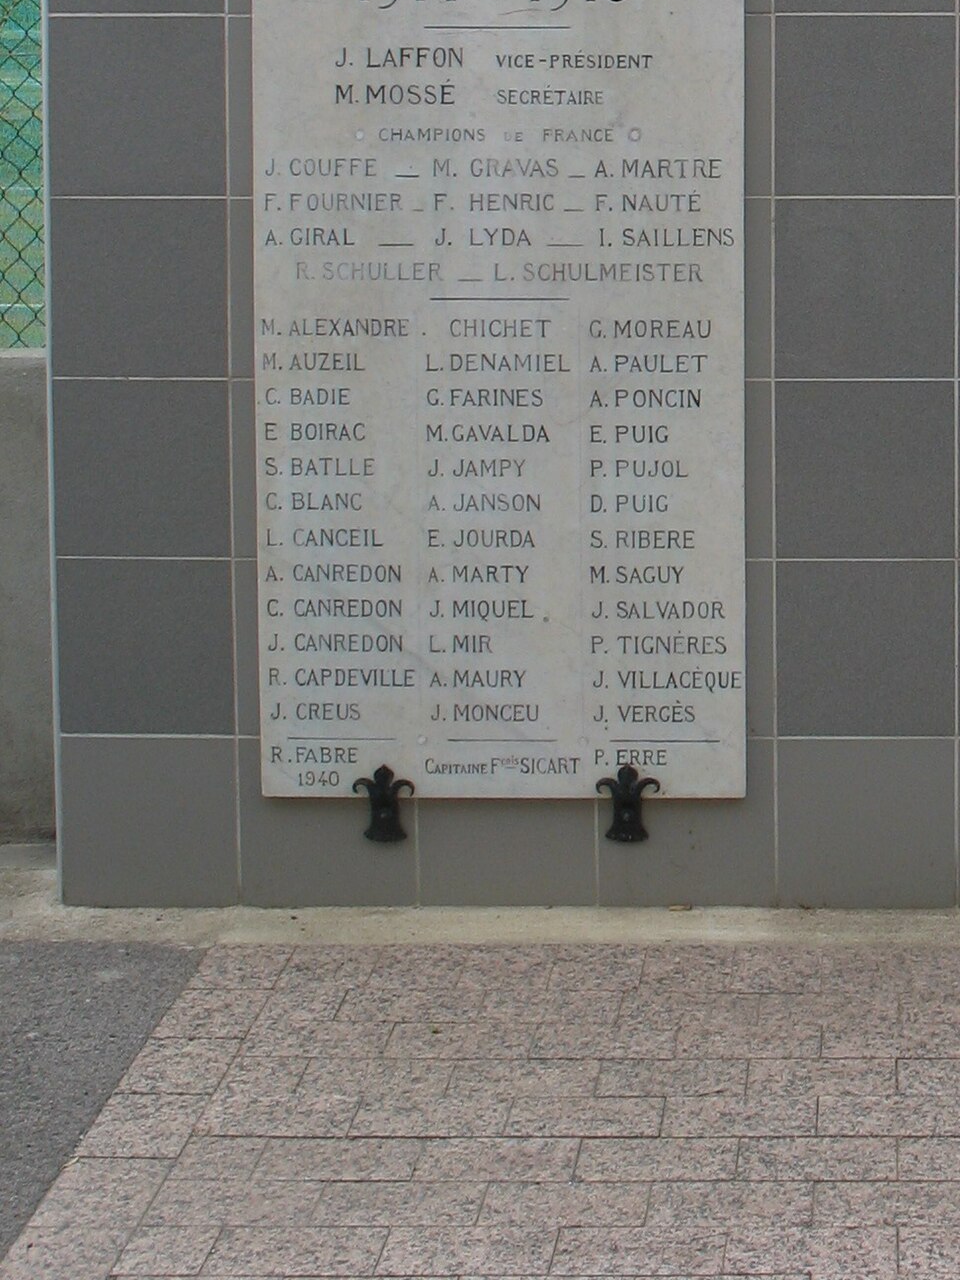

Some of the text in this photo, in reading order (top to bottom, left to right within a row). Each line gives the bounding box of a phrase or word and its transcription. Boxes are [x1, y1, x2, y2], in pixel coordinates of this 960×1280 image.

[367, 47, 463, 68] LAFFON
[496, 47, 653, 70] VICE-PRÉSIDENT
[365, 79, 456, 105] MOSSÉ
[497, 85, 604, 105] SECRÉTAIRE
[379, 128, 486, 142] CHAMPIONS
[543, 129, 614, 142] FRANCE
[289, 158, 377, 177] COUFFE
[470, 158, 559, 177] GRAVAS
[622, 159, 722, 178] MARTRE
[290, 190, 701, 212] FOURNIER HENRIC NAUTÉ
[290, 228, 735, 247] GIRAL LYDA SAILLENS
[322, 262, 703, 282] SCHULLER SCHULMEISTER
[289, 319, 409, 337] ALEXANDRE
[450, 319, 552, 338] CHICHET
[614, 320, 711, 338] MOREAU
[289, 353, 366, 371] AUZEIL
[450, 354, 571, 372] DENAMIEL
[615, 355, 708, 372] PAULET
[290, 388, 351, 406] BADIE
[450, 389, 543, 407] FARINES
[615, 389, 702, 408] PONCIN
[290, 423, 366, 441] BOIRAC
[615, 425, 669, 443] PUIG
[291, 458, 375, 476] BATLLE
[453, 459, 526, 477] JAMPY
[616, 460, 688, 478] PUJOL
[292, 492, 362, 511] BLANC
[453, 493, 541, 512] JANSON
[616, 495, 668, 512] PUIG
[293, 529, 384, 547] CANCEIL
[453, 530, 535, 548] JOURDA
[616, 530, 695, 549] RIBERE
[293, 564, 402, 583] CANREDON
[452, 565, 529, 583] MARTY
[616, 566, 684, 584] SAGUY
[294, 599, 402, 618] CANREDON
[452, 600, 534, 622] MIQUEL
[616, 601, 726, 619] SALVADOR
[294, 634, 403, 653] CANREDON
[452, 635, 493, 653] MIR
[295, 669, 415, 687] CAPDEVILLE
[453, 670, 527, 687] MAURY
[296, 703, 360, 720] CREUS
[453, 704, 539, 721] MONCEU
[296, 747, 358, 763] FABRE
[616, 750, 667, 766] ERRE
[520, 758, 580, 774] SICART
[298, 772, 339, 787] 1940
